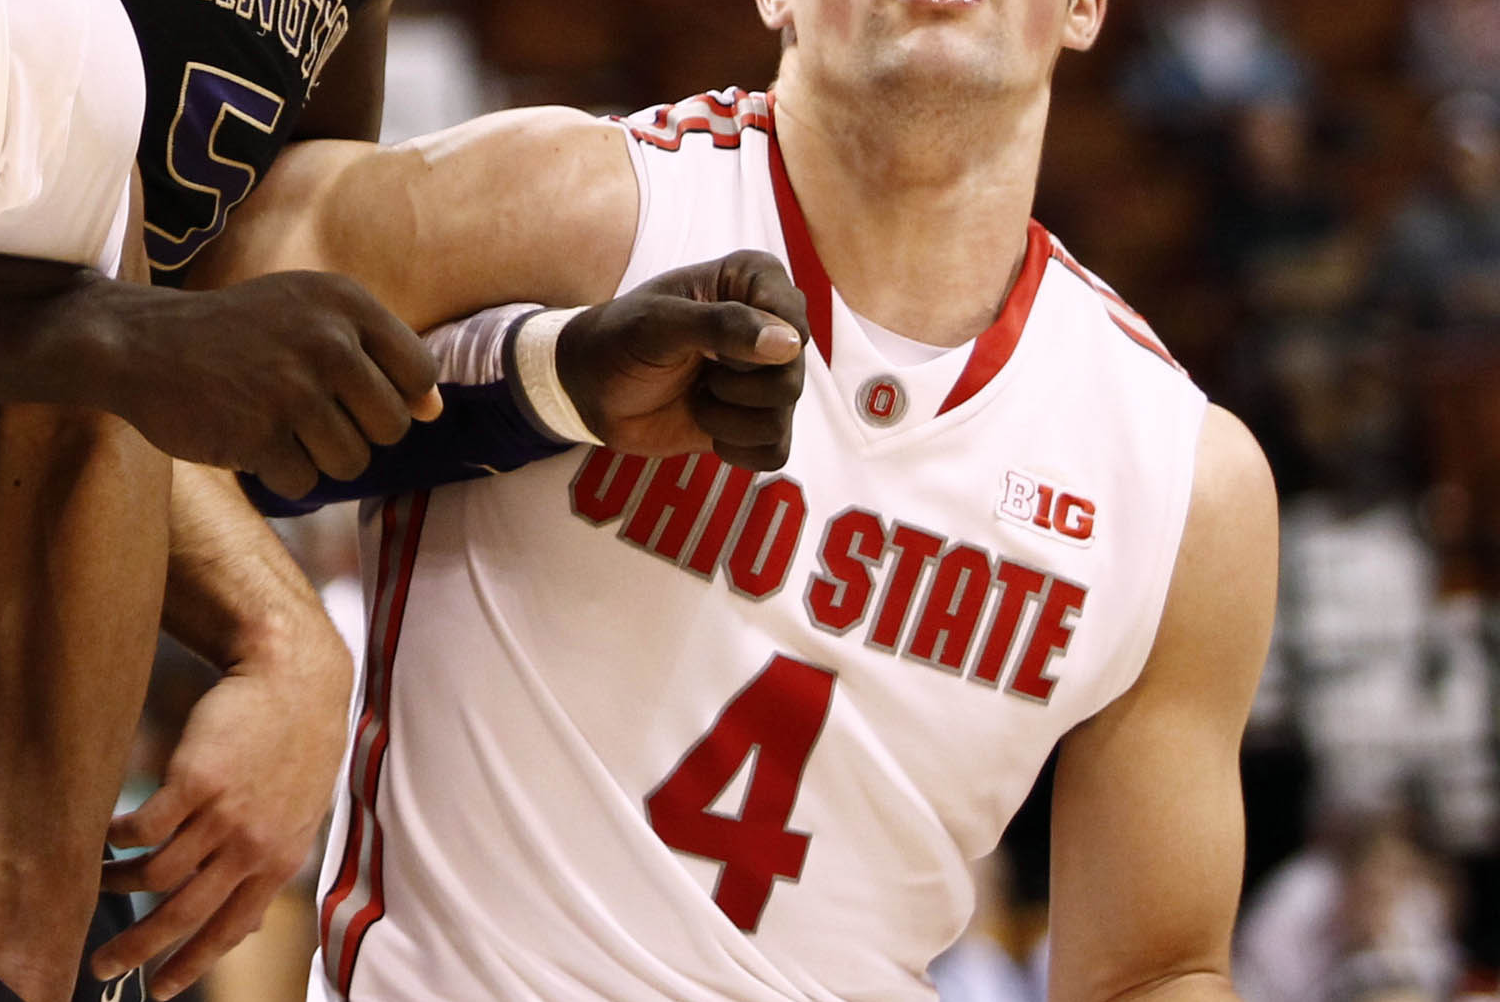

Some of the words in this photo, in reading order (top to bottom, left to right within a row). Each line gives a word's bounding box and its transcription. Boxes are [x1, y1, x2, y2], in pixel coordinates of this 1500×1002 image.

[144, 60, 285, 271] 5
[568, 444, 809, 603] OHIO
[801, 503, 1090, 707] STATE
[642, 651, 840, 934] 4
